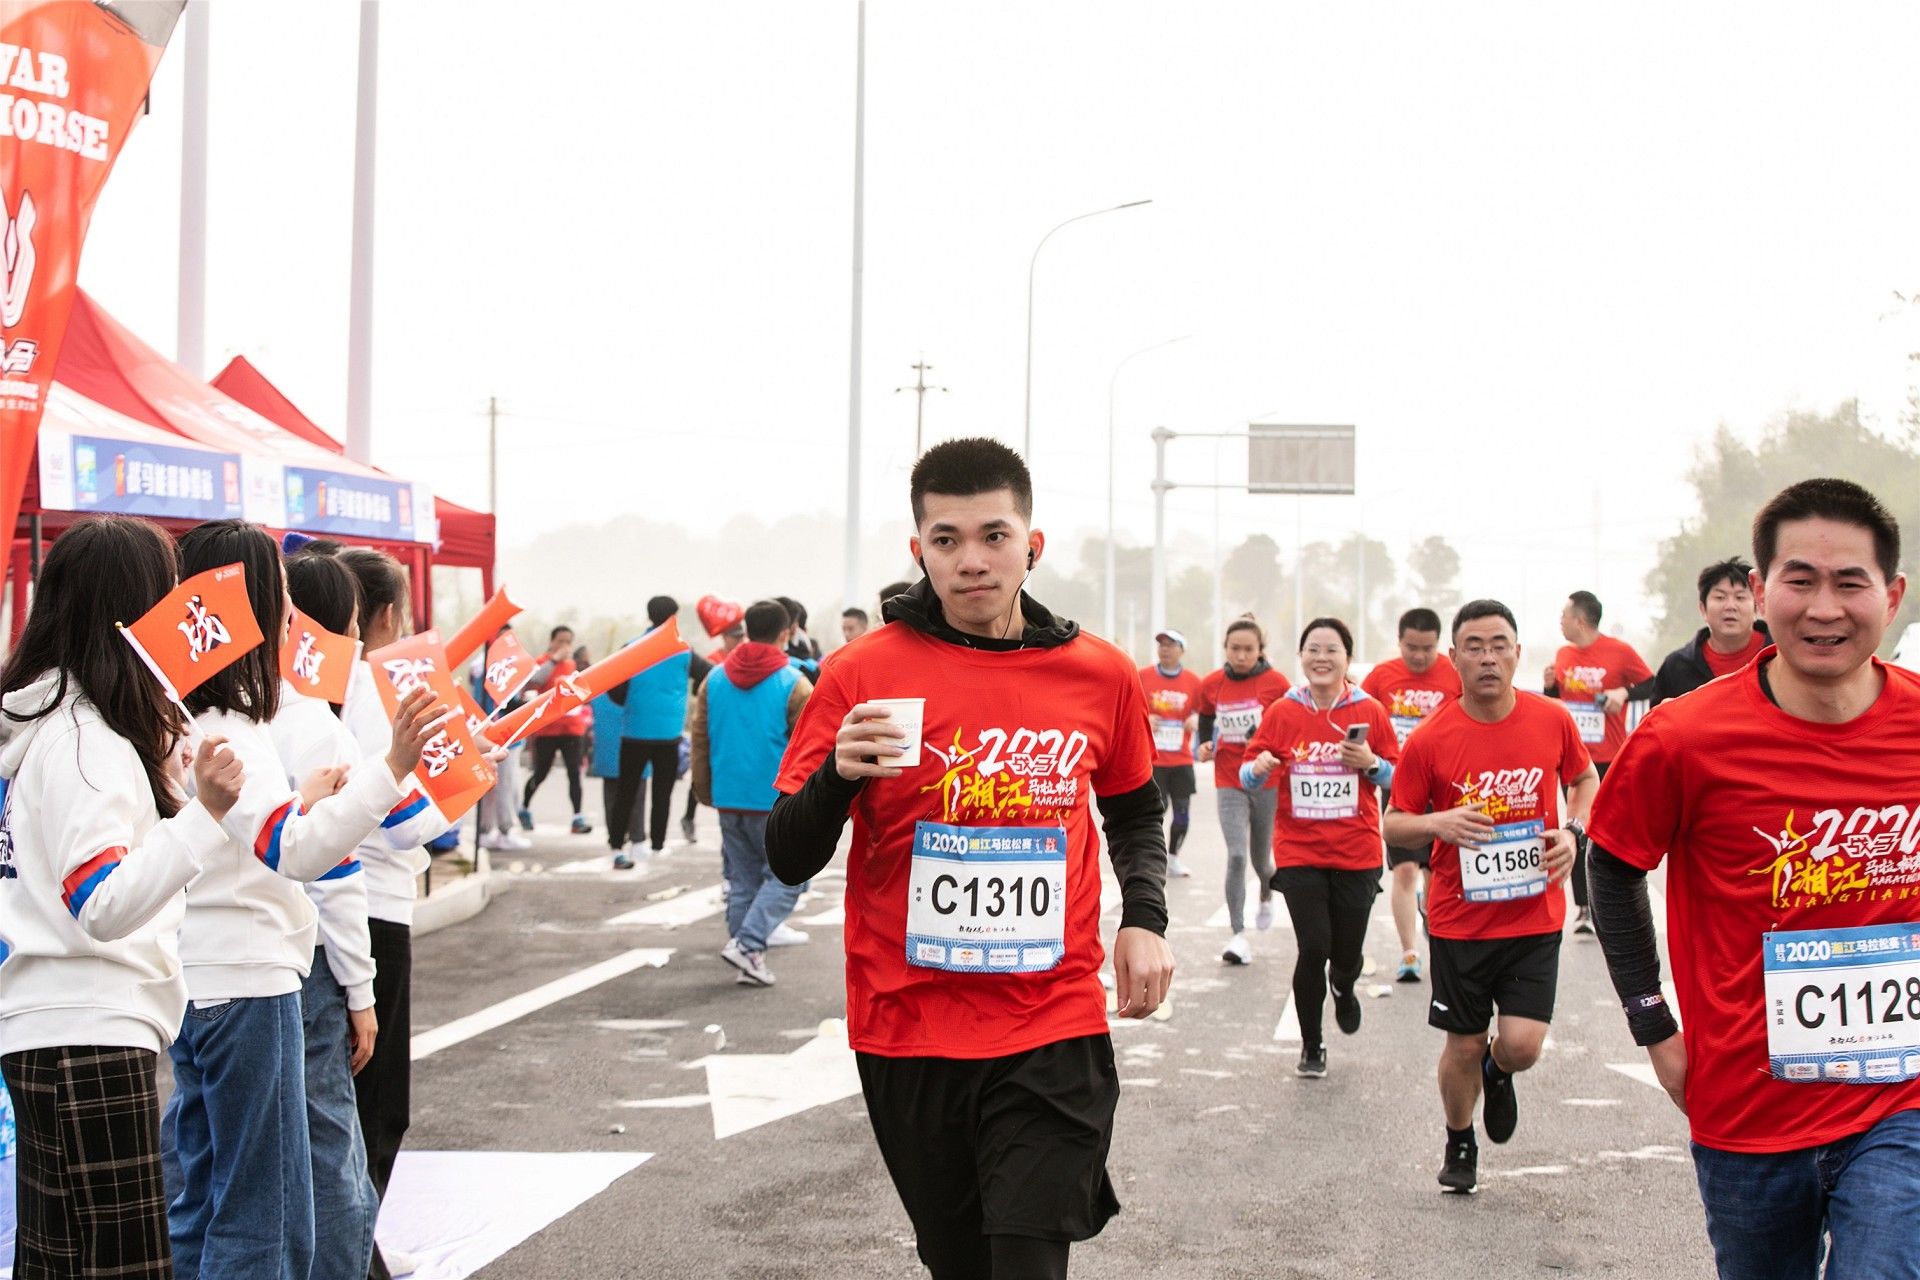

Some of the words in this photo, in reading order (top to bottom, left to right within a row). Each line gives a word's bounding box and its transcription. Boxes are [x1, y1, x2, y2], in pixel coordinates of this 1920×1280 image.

[978, 727, 1088, 778] 2020
[961, 772, 1033, 809] 湘江
[1301, 781, 1351, 798] D1224
[1479, 767, 1543, 799] 2020
[931, 832, 968, 855] 2020
[1475, 846, 1540, 875] C1586
[1790, 855, 1870, 896] 湘江
[931, 874, 1050, 917] C1310
[1786, 940, 1831, 962] 2020
[1795, 976, 1920, 1029] C1128
